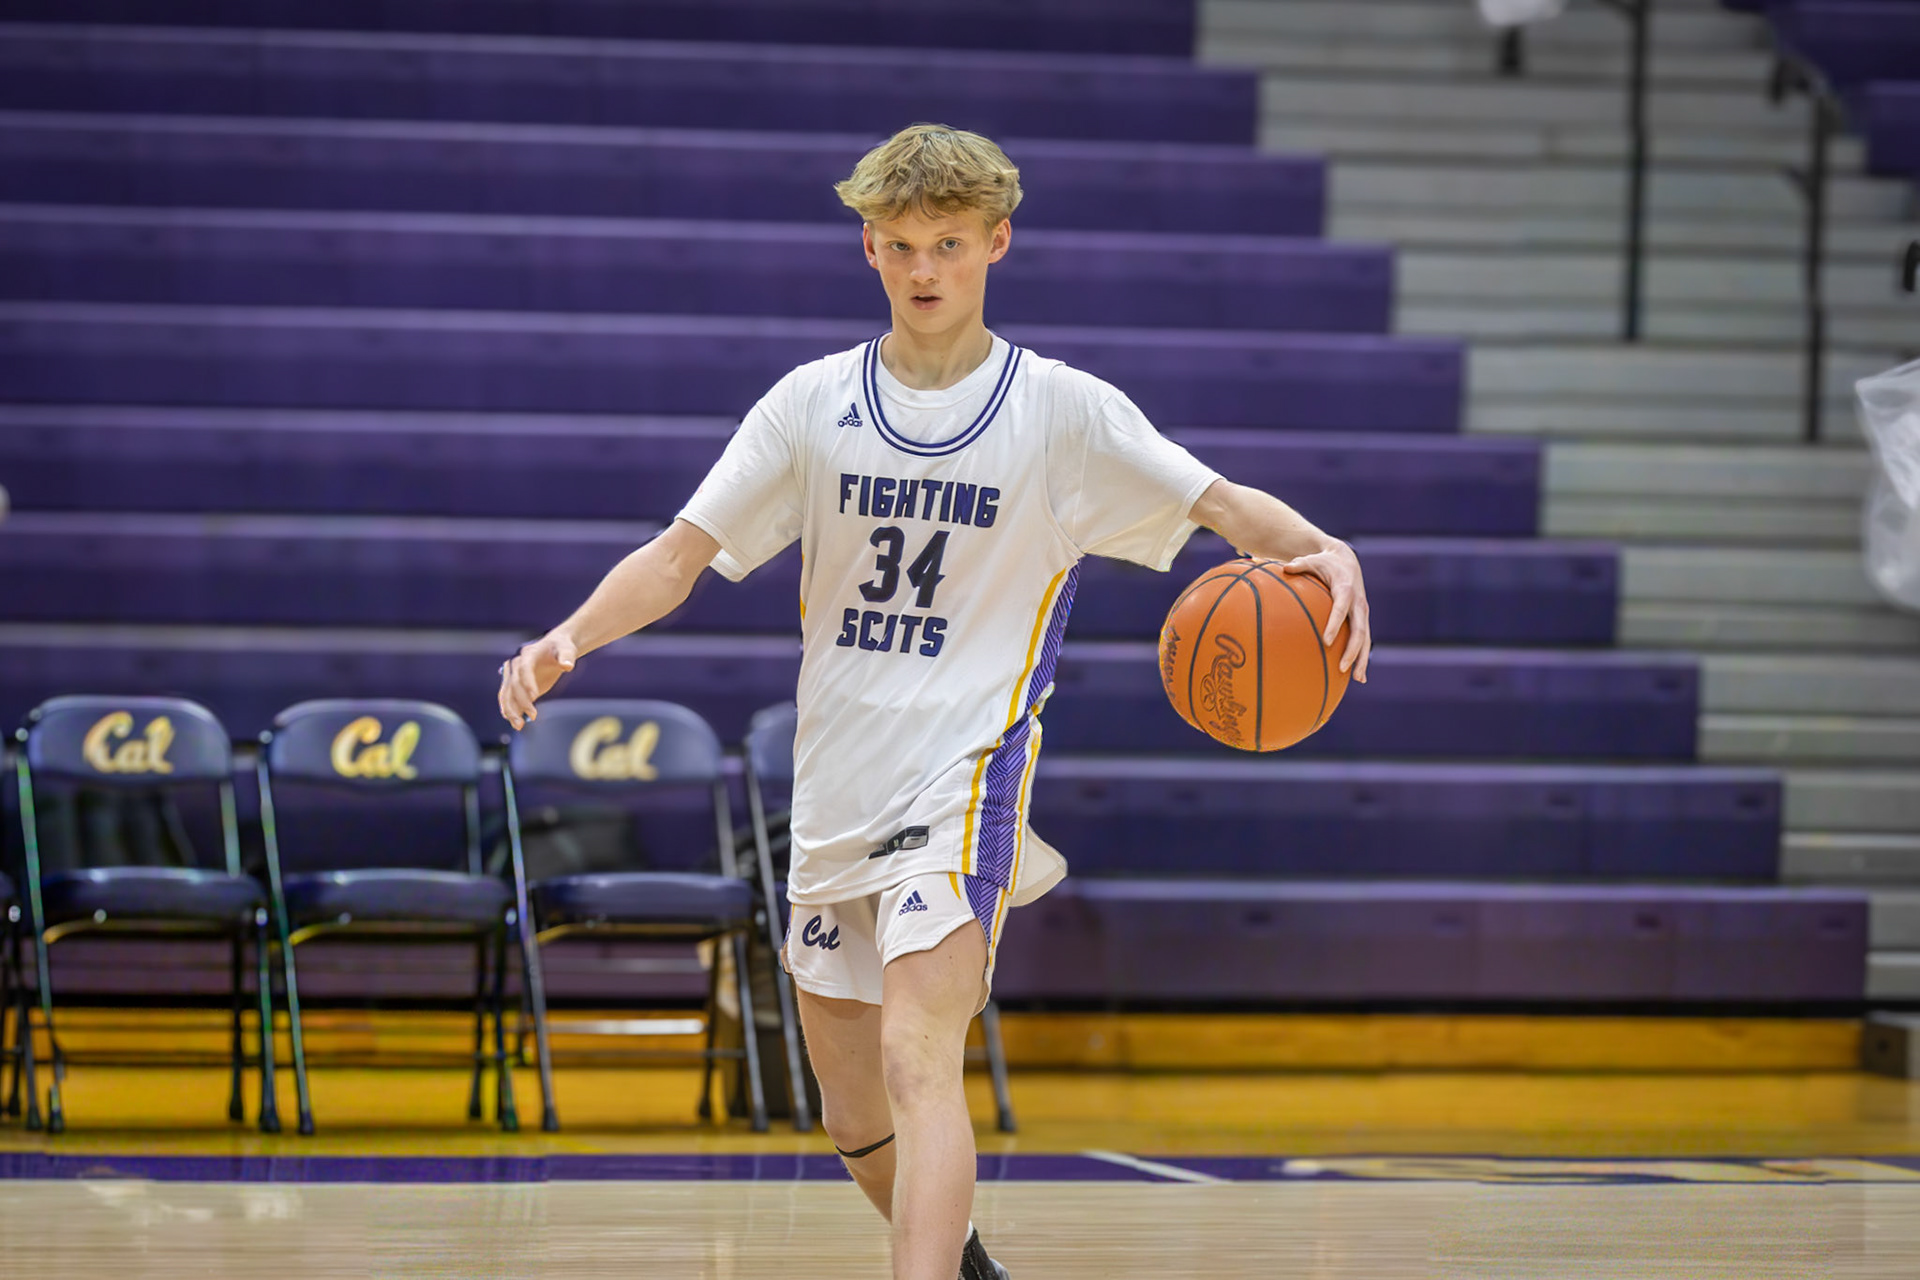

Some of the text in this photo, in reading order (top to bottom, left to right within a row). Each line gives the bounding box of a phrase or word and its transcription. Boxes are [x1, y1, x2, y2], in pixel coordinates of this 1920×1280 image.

[837, 417, 863, 427] adas
[839, 473, 1000, 528] FIGHTING
[858, 526, 950, 608] 34
[83, 711, 174, 774] Cal
[331, 716, 421, 780] Cal
[571, 716, 660, 782] Cal
[898, 903, 928, 916] adidas
